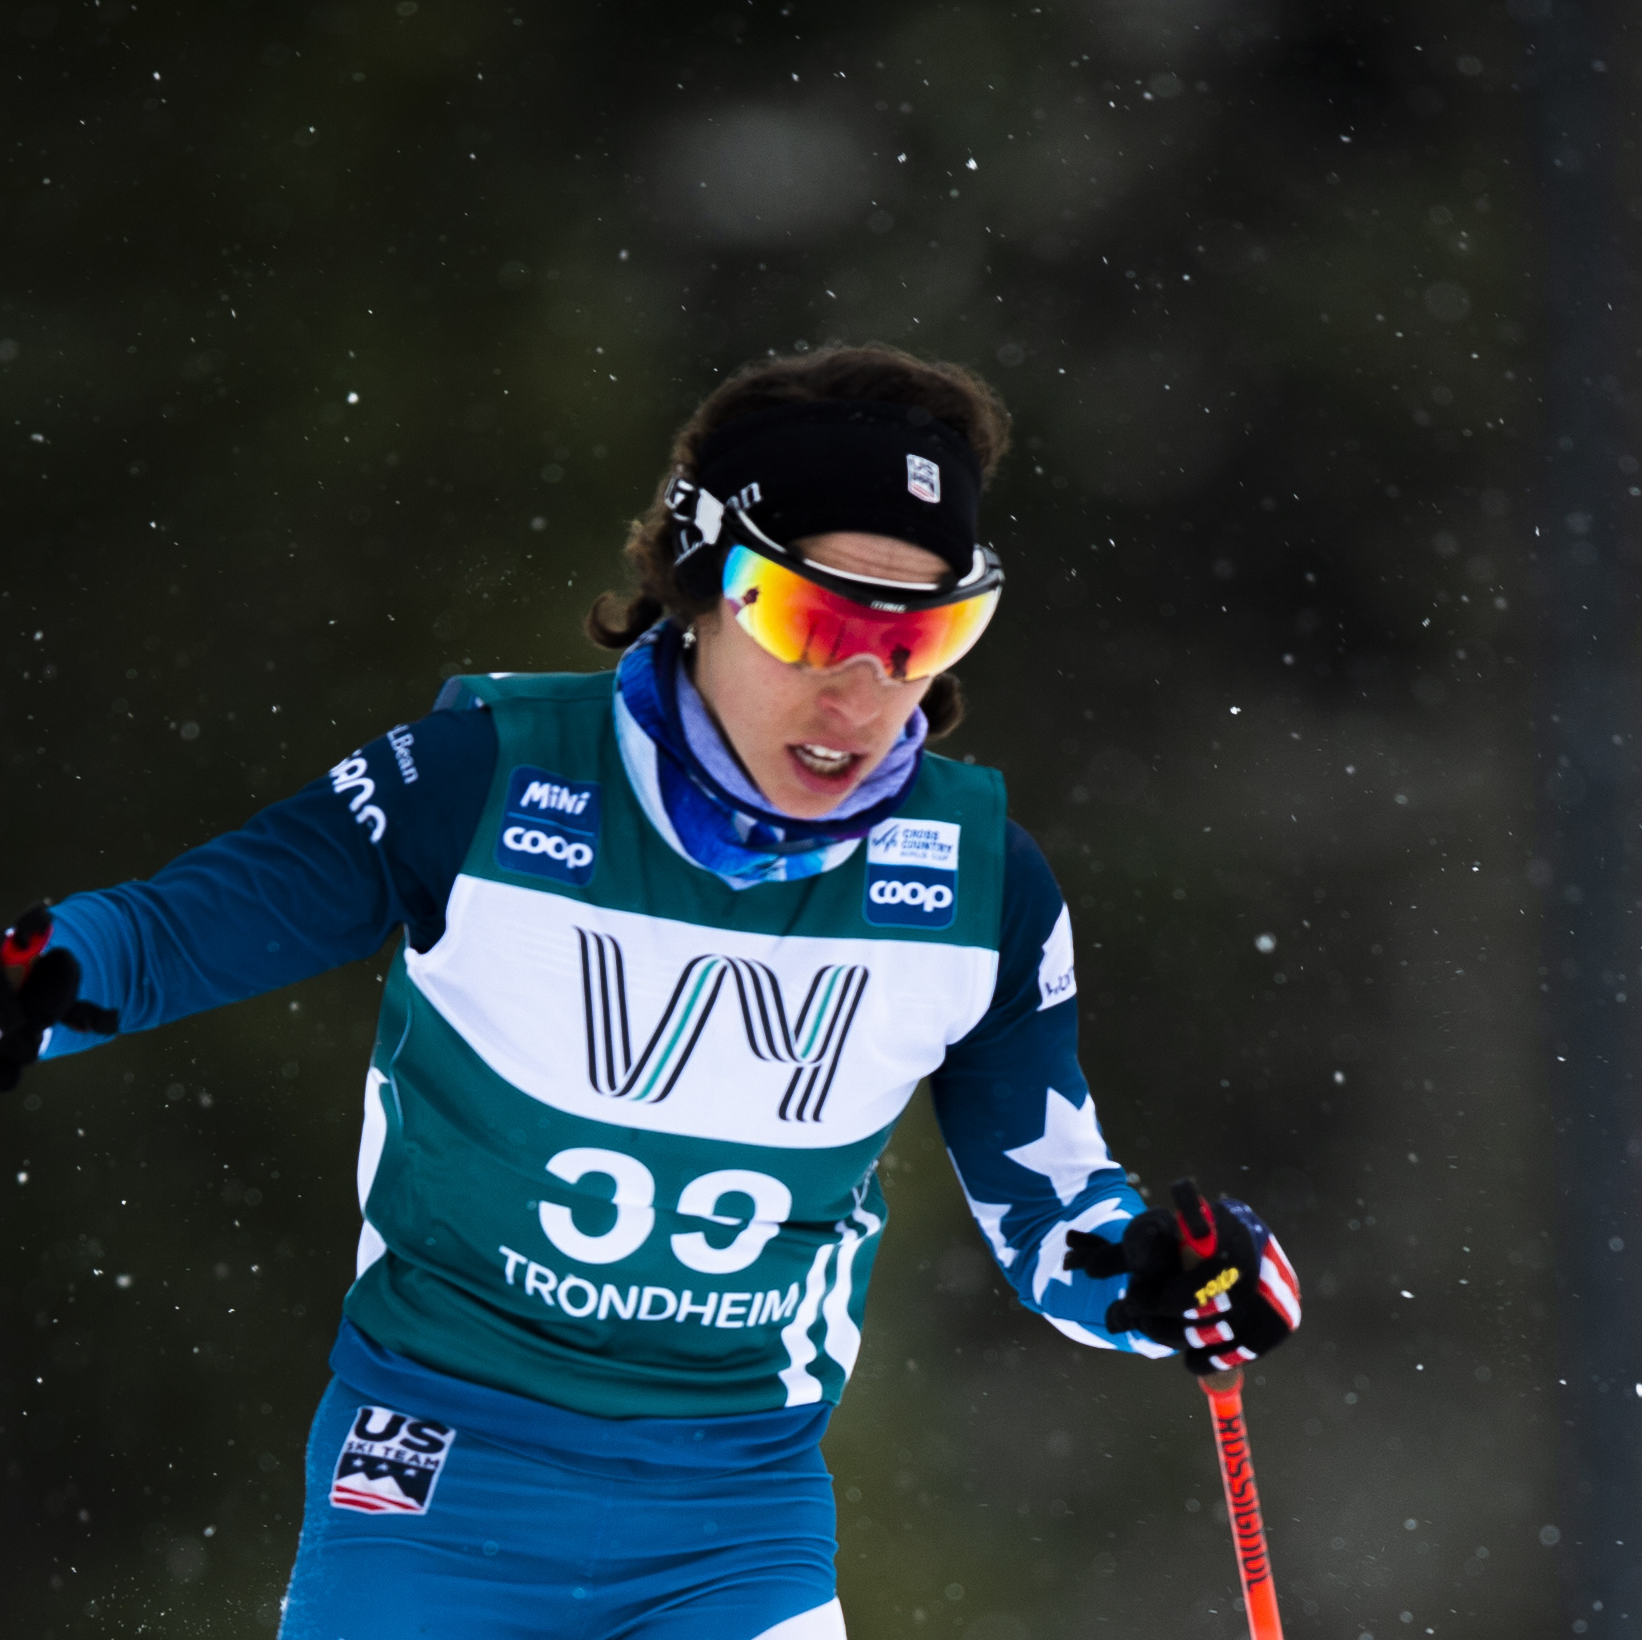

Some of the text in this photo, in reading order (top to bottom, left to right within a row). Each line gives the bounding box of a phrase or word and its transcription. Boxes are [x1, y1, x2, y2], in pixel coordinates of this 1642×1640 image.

[502, 826, 594, 870] coop
[869, 880, 954, 913] coop
[538, 1146, 793, 1274] 39
[498, 1245, 800, 1329] TRONDHEIM
[354, 1407, 450, 1455] US
